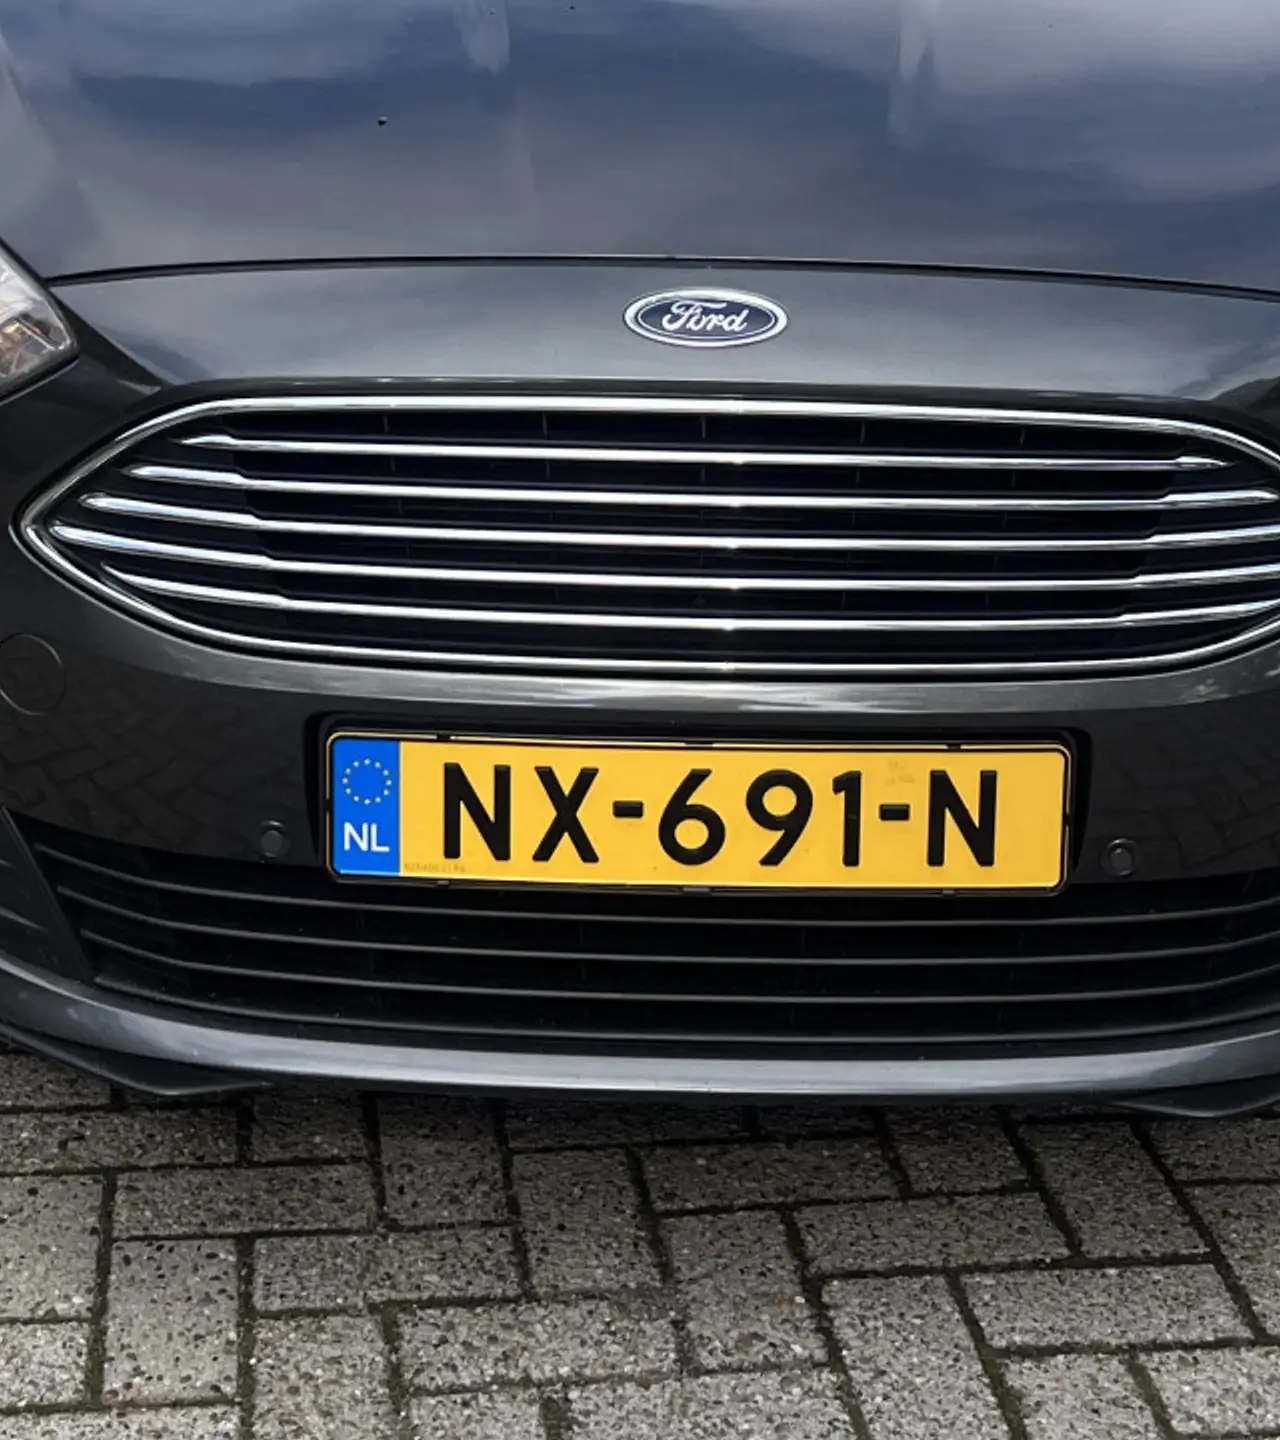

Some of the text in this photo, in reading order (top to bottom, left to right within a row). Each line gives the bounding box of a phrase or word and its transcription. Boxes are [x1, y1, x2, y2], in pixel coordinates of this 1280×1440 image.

[662, 299, 749, 332] Ford
[443, 762, 997, 868] NX-691-N
[343, 821, 390, 852] NL
